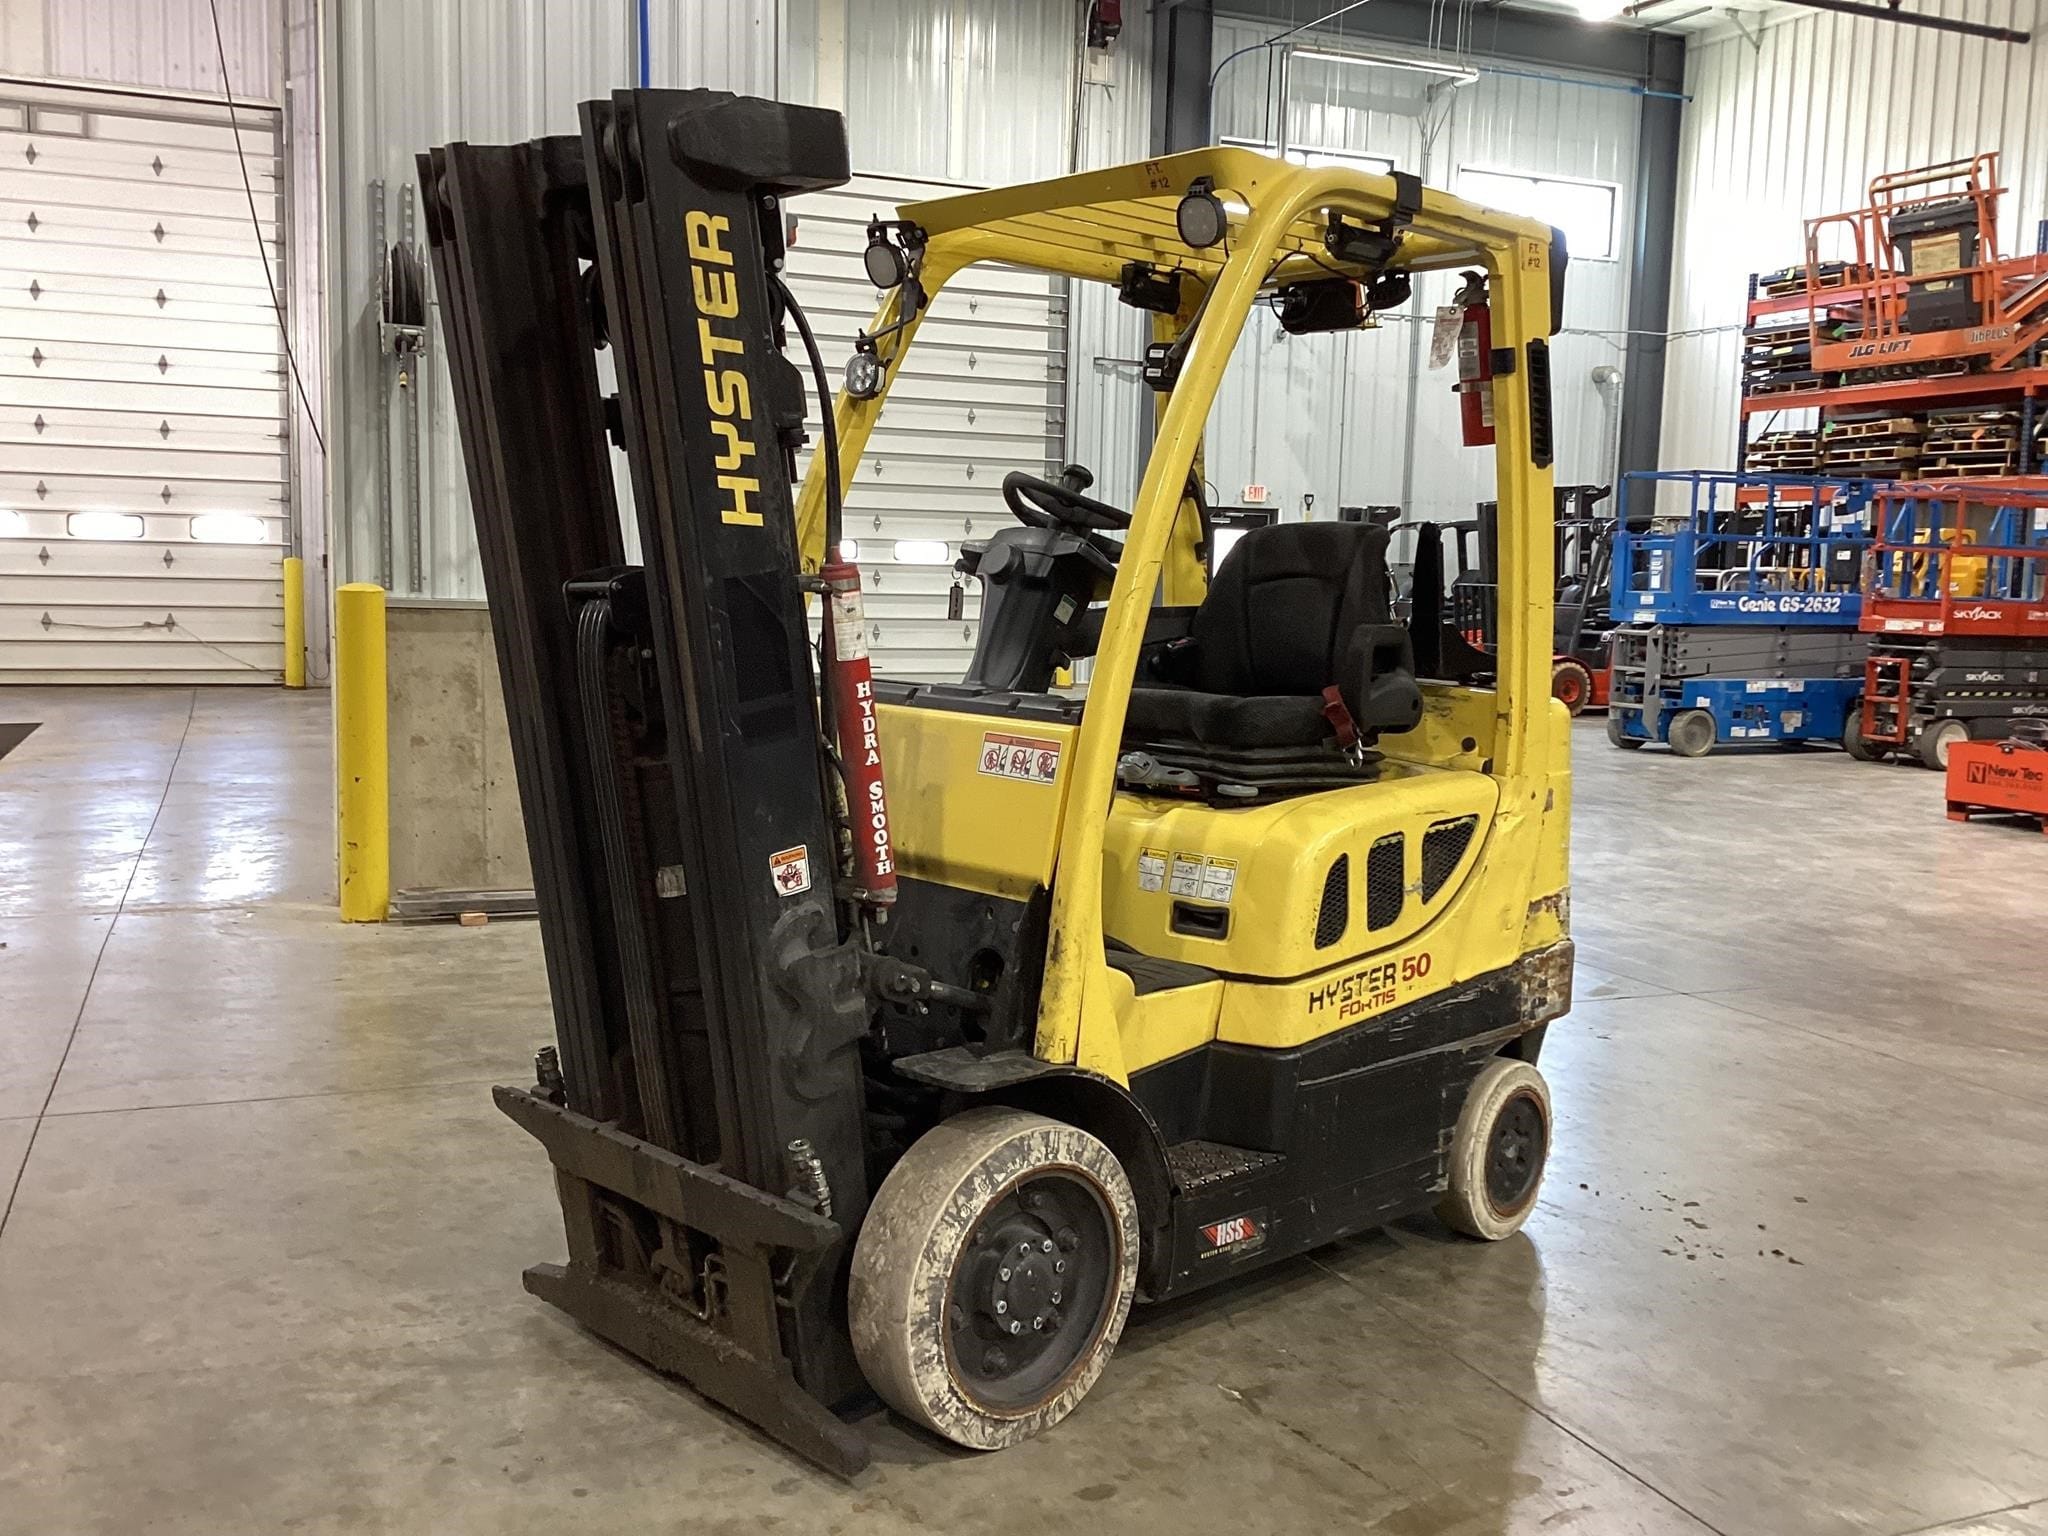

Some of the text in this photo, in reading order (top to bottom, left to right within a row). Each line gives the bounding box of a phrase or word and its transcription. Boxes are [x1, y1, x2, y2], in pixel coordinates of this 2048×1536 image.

[1150, 177, 1170, 191] #12
[1849, 339, 1912, 358] JLG LIFT
[685, 210, 764, 527] HYSTER
[1248, 486, 1265, 500] EXIT
[1738, 596, 1841, 613] Genie GS-2632
[1953, 607, 2002, 621] SKYJACK
[856, 682, 892, 876] HYDRA SMOOTH
[1988, 764, 2044, 781] New Tec
[1402, 953, 1432, 981] 50
[1216, 1218, 1244, 1246] HSS
